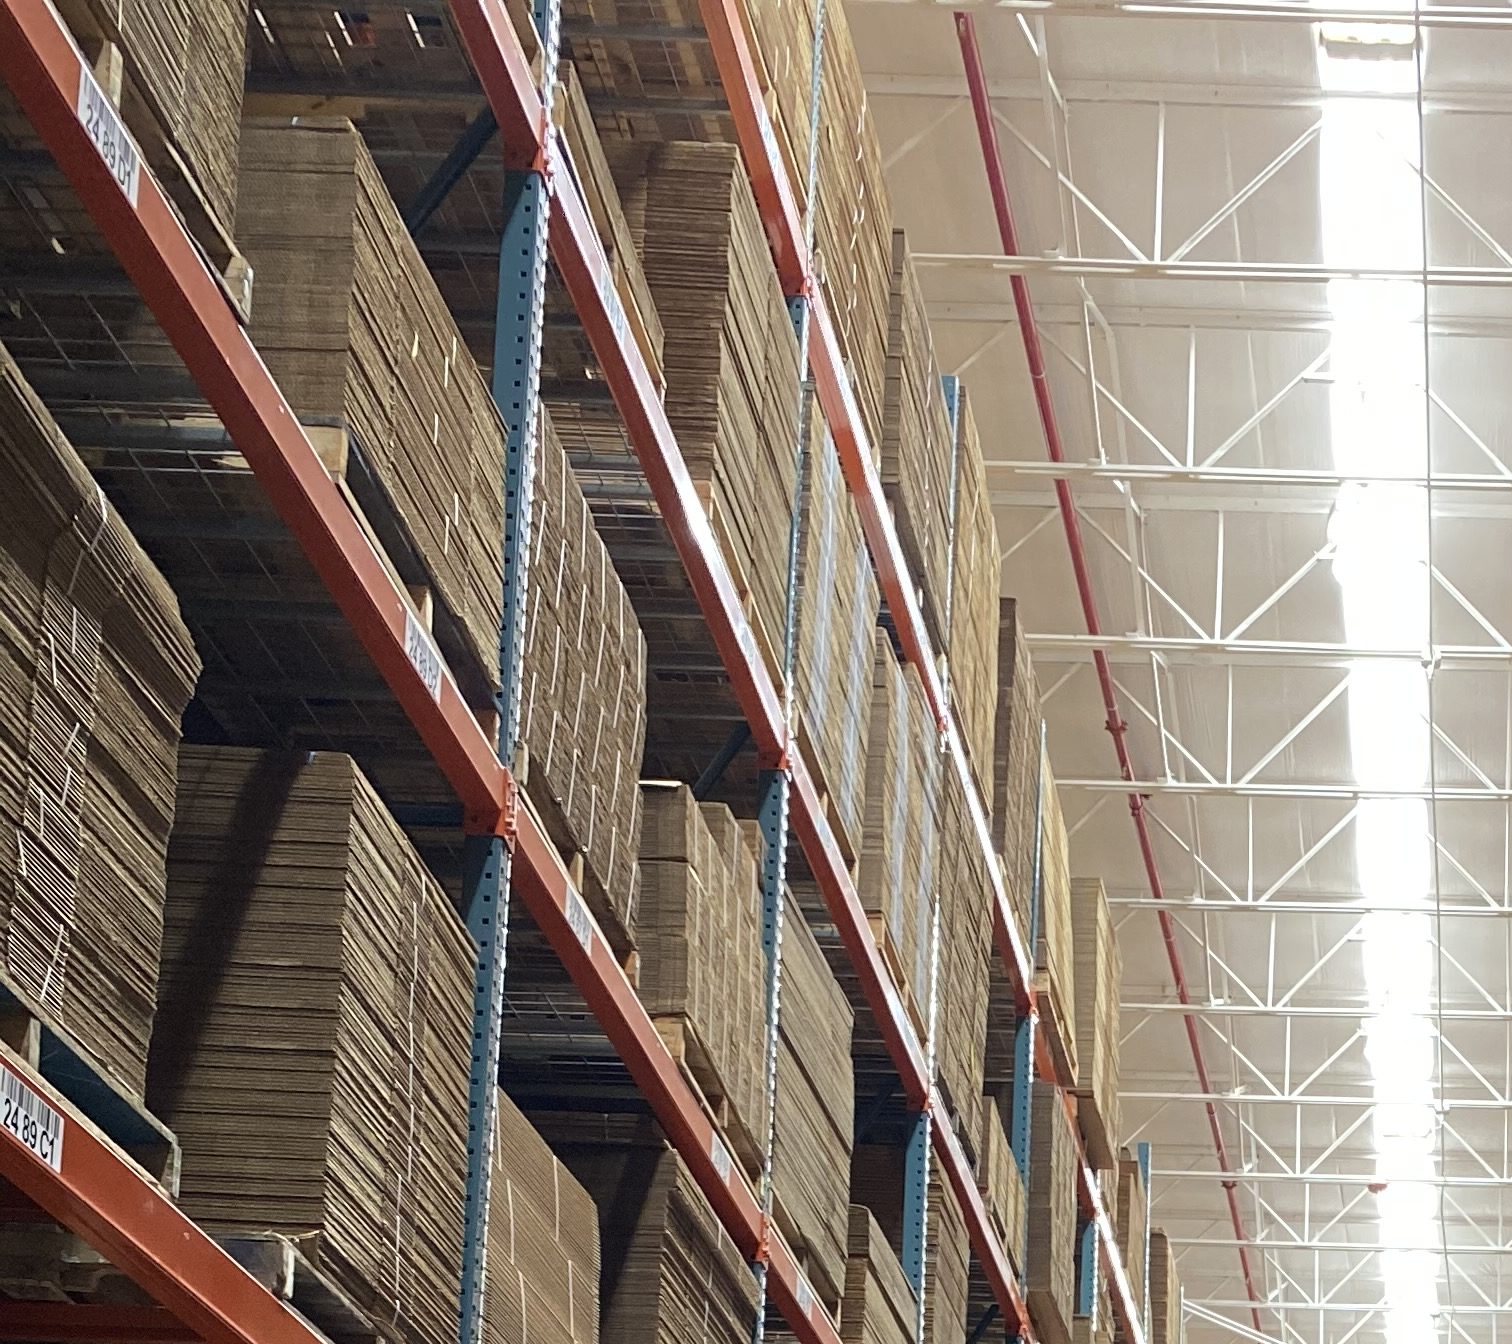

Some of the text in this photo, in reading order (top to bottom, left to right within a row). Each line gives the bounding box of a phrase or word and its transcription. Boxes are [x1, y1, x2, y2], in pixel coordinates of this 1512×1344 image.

[85, 103, 131, 196] 24 89 D1
[408, 636, 418, 663] 24
[428, 665, 437, 696] D2
[3, 1098, 55, 1166] 24 89 C1
